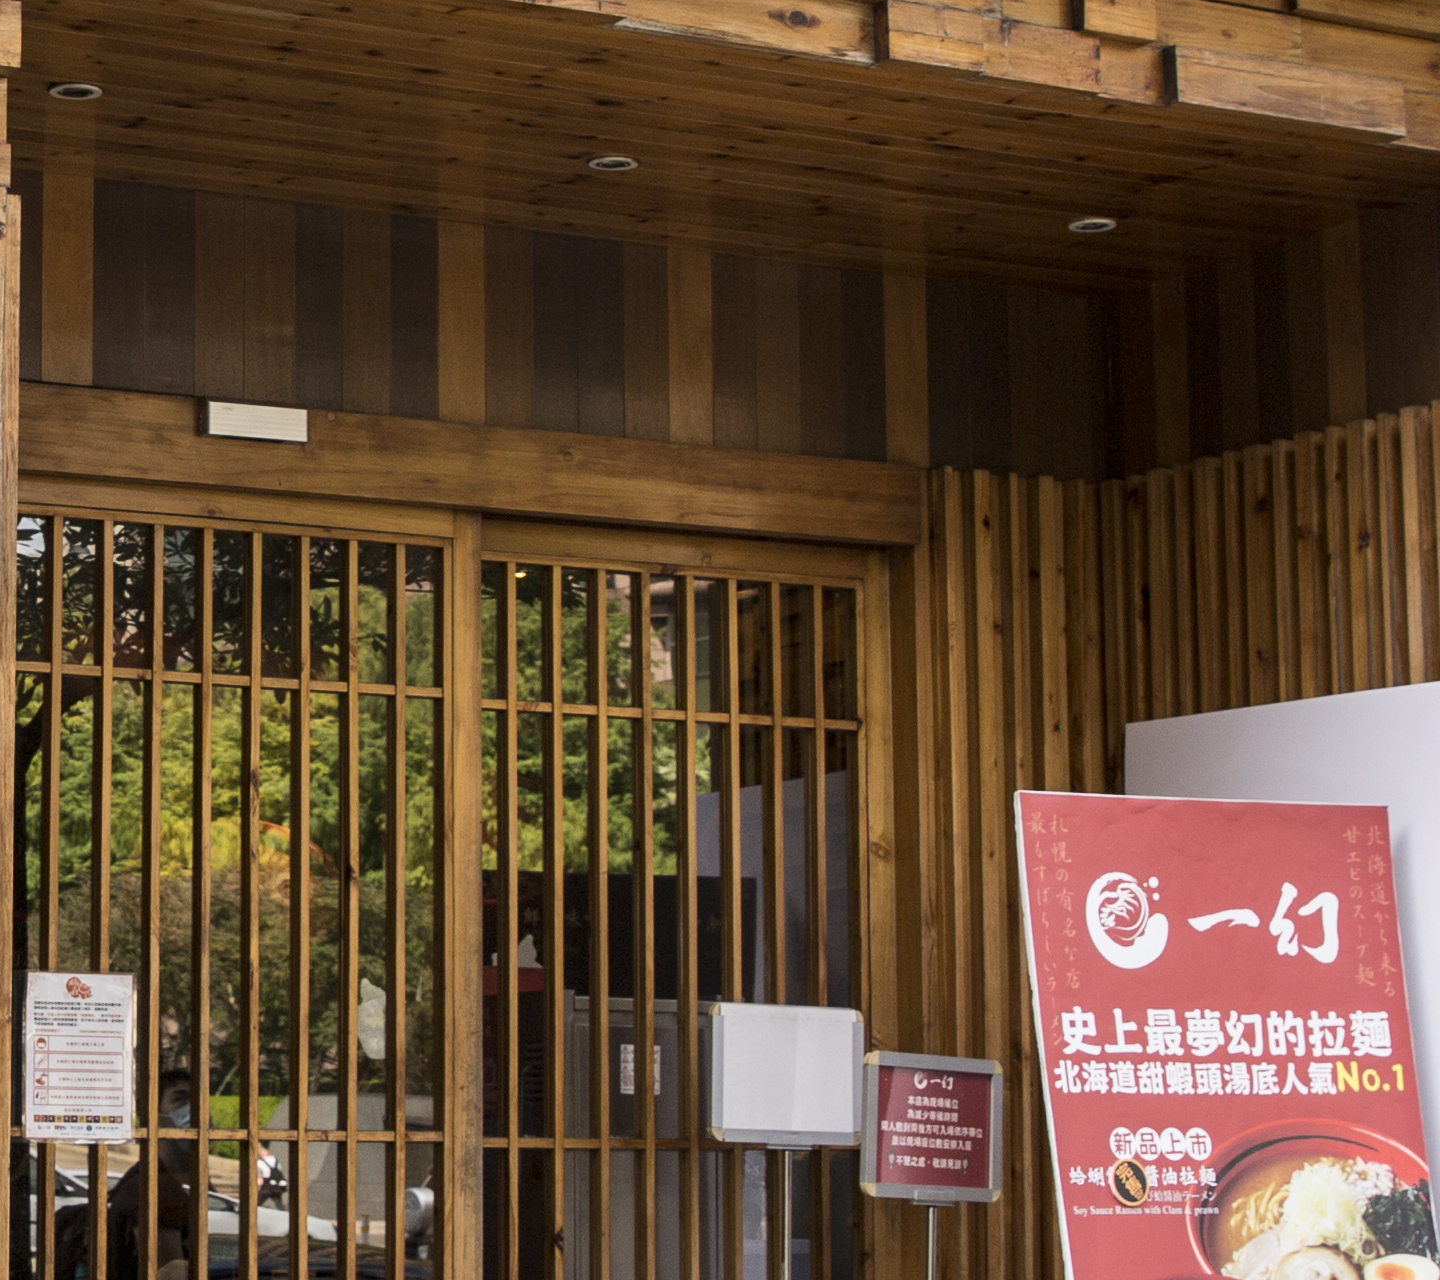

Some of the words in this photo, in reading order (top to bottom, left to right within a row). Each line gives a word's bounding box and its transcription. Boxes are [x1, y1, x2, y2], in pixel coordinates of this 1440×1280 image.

[1187, 881, 1340, 964] 一幻
[1061, 1006, 1393, 1057] 史上最夢幻的拉麵
[929, 1075, 954, 1090] 一幻
[1113, 1131, 1208, 1157] 新品上市
[1069, 1165, 1218, 1187] 蛤蜊醬油拉麵
[1073, 1206, 1088, 1217] Soy
[1090, 1206, 1113, 1216] Sauce
[1115, 1206, 1143, 1216] Ramen
[1144, 1205, 1161, 1215] with
[1163, 1206, 1183, 1215] Clam
[1195, 1207, 1219, 1218] prawn
